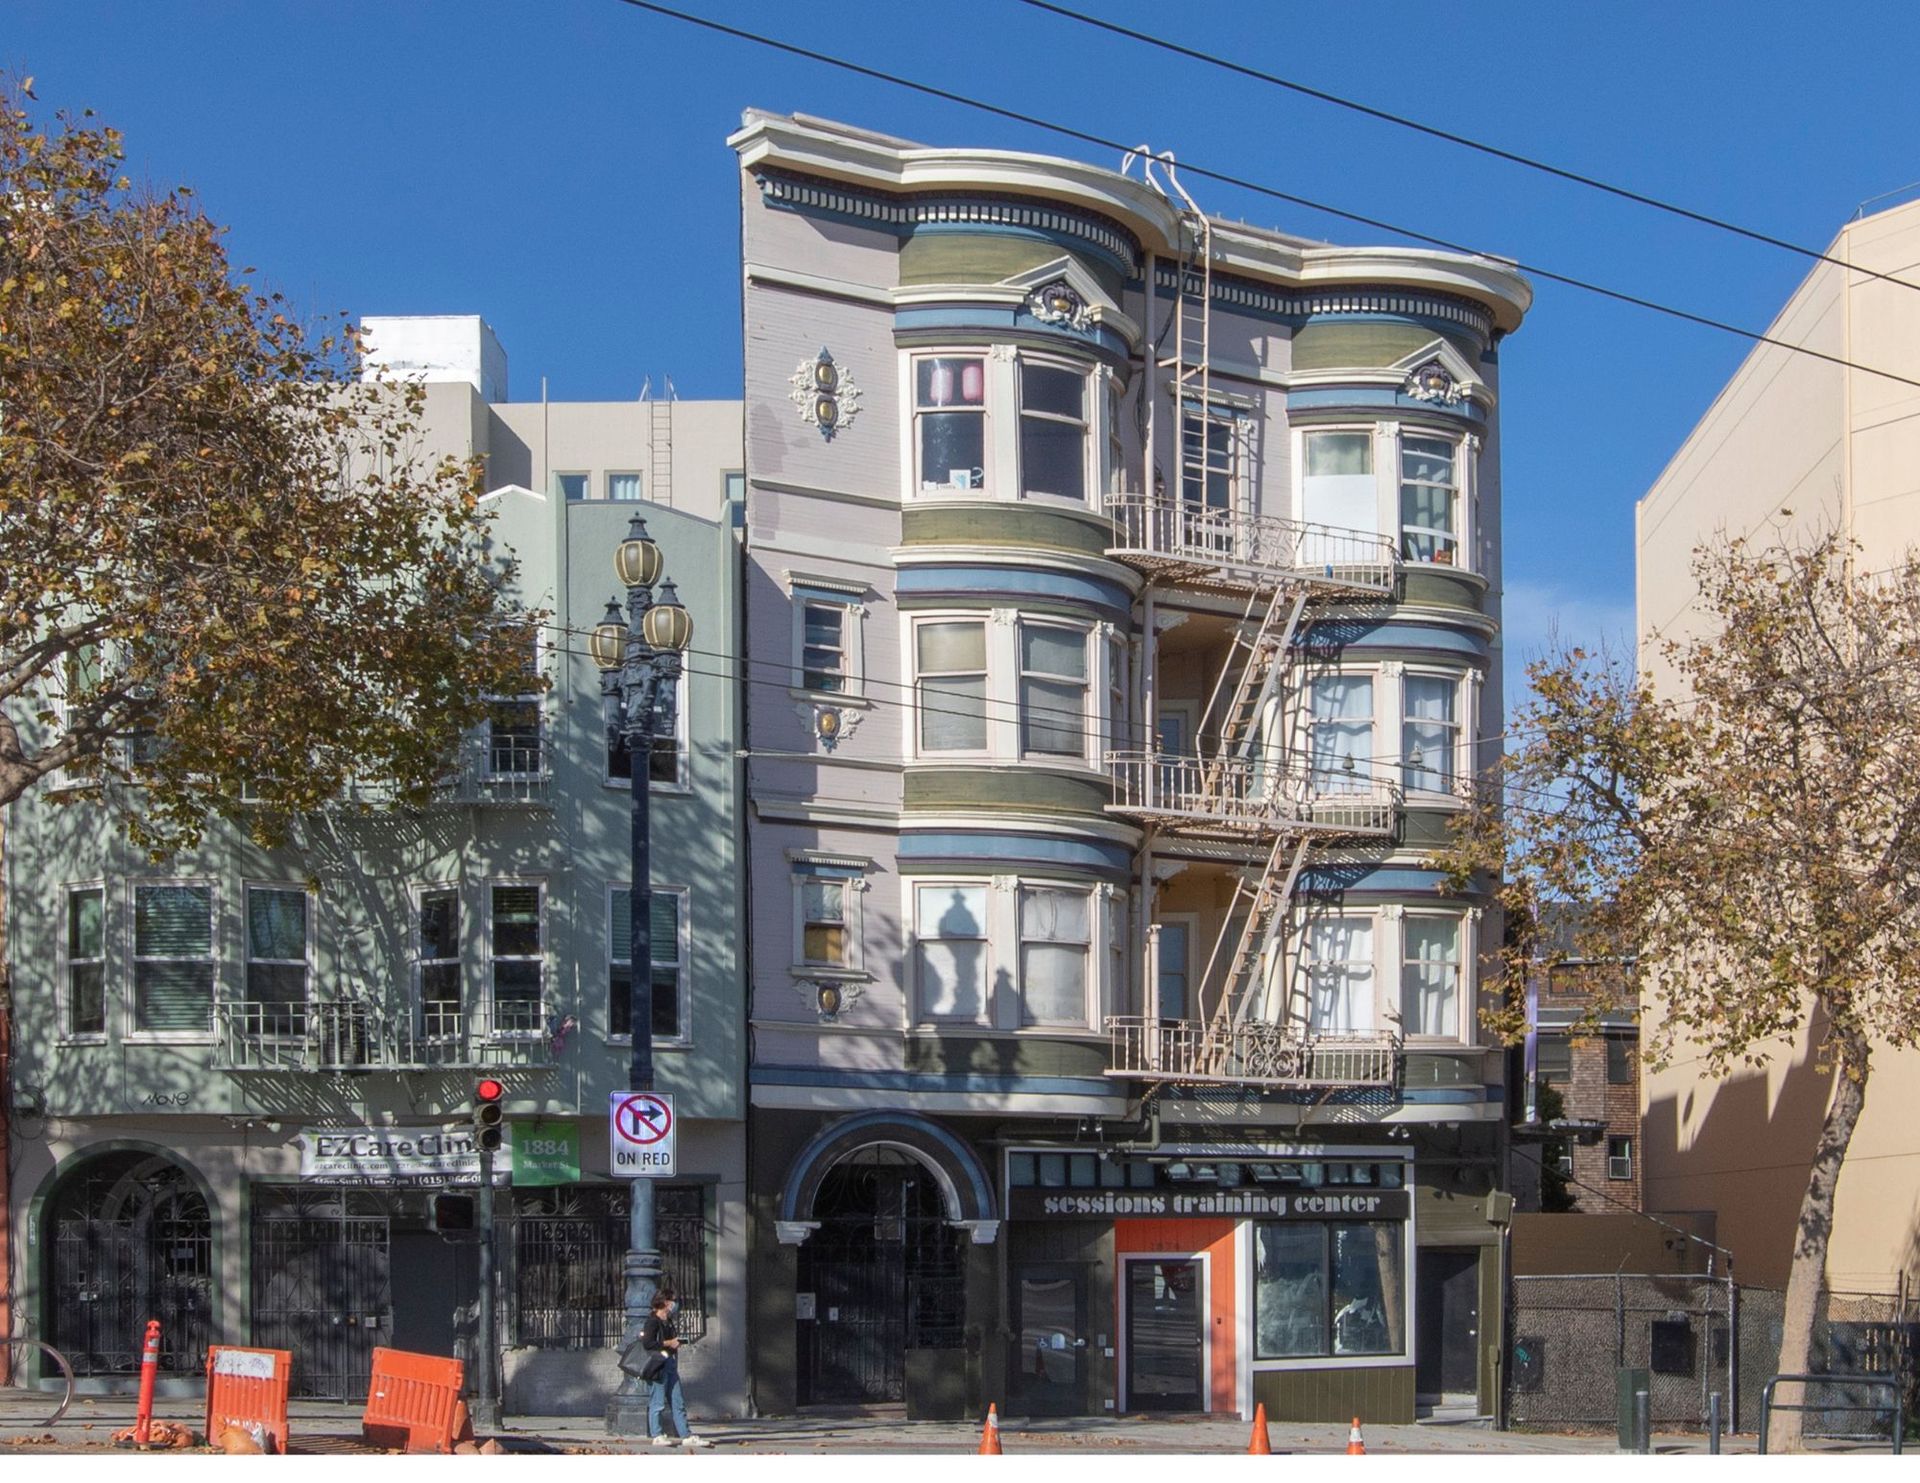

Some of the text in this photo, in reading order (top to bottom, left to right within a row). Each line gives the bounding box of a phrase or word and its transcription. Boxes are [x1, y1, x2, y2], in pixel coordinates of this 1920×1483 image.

[316, 1135, 477, 1157] EZCare Clin
[522, 1139, 569, 1156] 1884
[616, 1152, 670, 1166] ON RED
[1044, 1191, 1381, 1217] sessions training center
